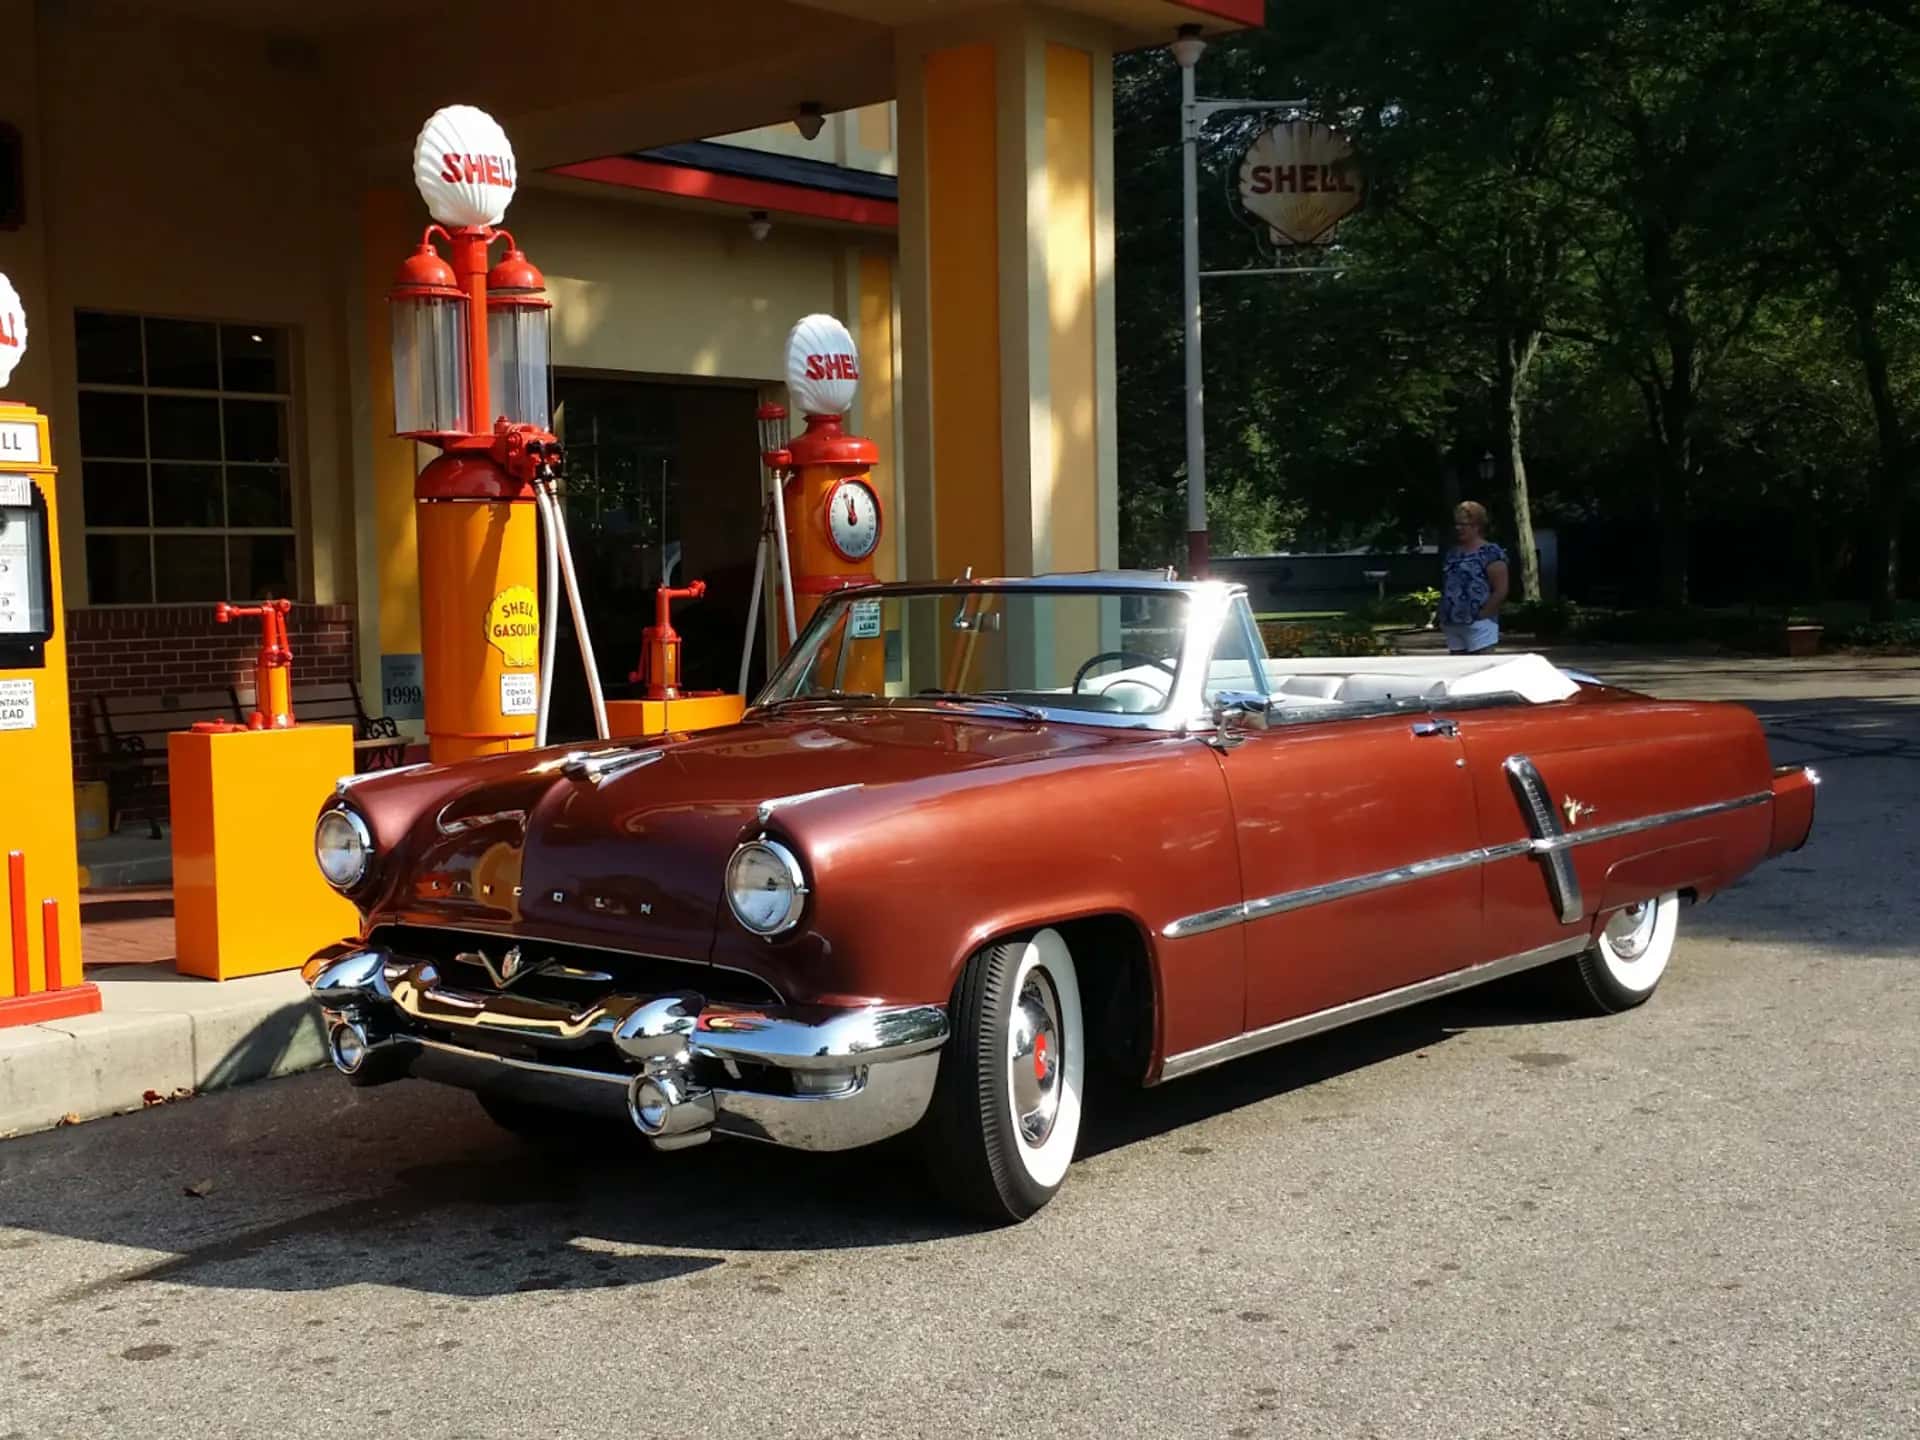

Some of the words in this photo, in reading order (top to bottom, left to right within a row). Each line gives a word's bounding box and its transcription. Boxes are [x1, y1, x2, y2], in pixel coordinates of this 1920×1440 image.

[442, 153, 513, 188] SHELL
[1251, 164, 1355, 193] SHELL
[806, 353, 859, 380] SHEL
[502, 601, 533, 618] SHELL
[494, 623, 537, 638] GASOLIN
[384, 685, 422, 705] 1999
[511, 697, 531, 706] LEAD
[0, 708, 24, 720] EAD
[431, 879, 652, 915] LINCOLN
